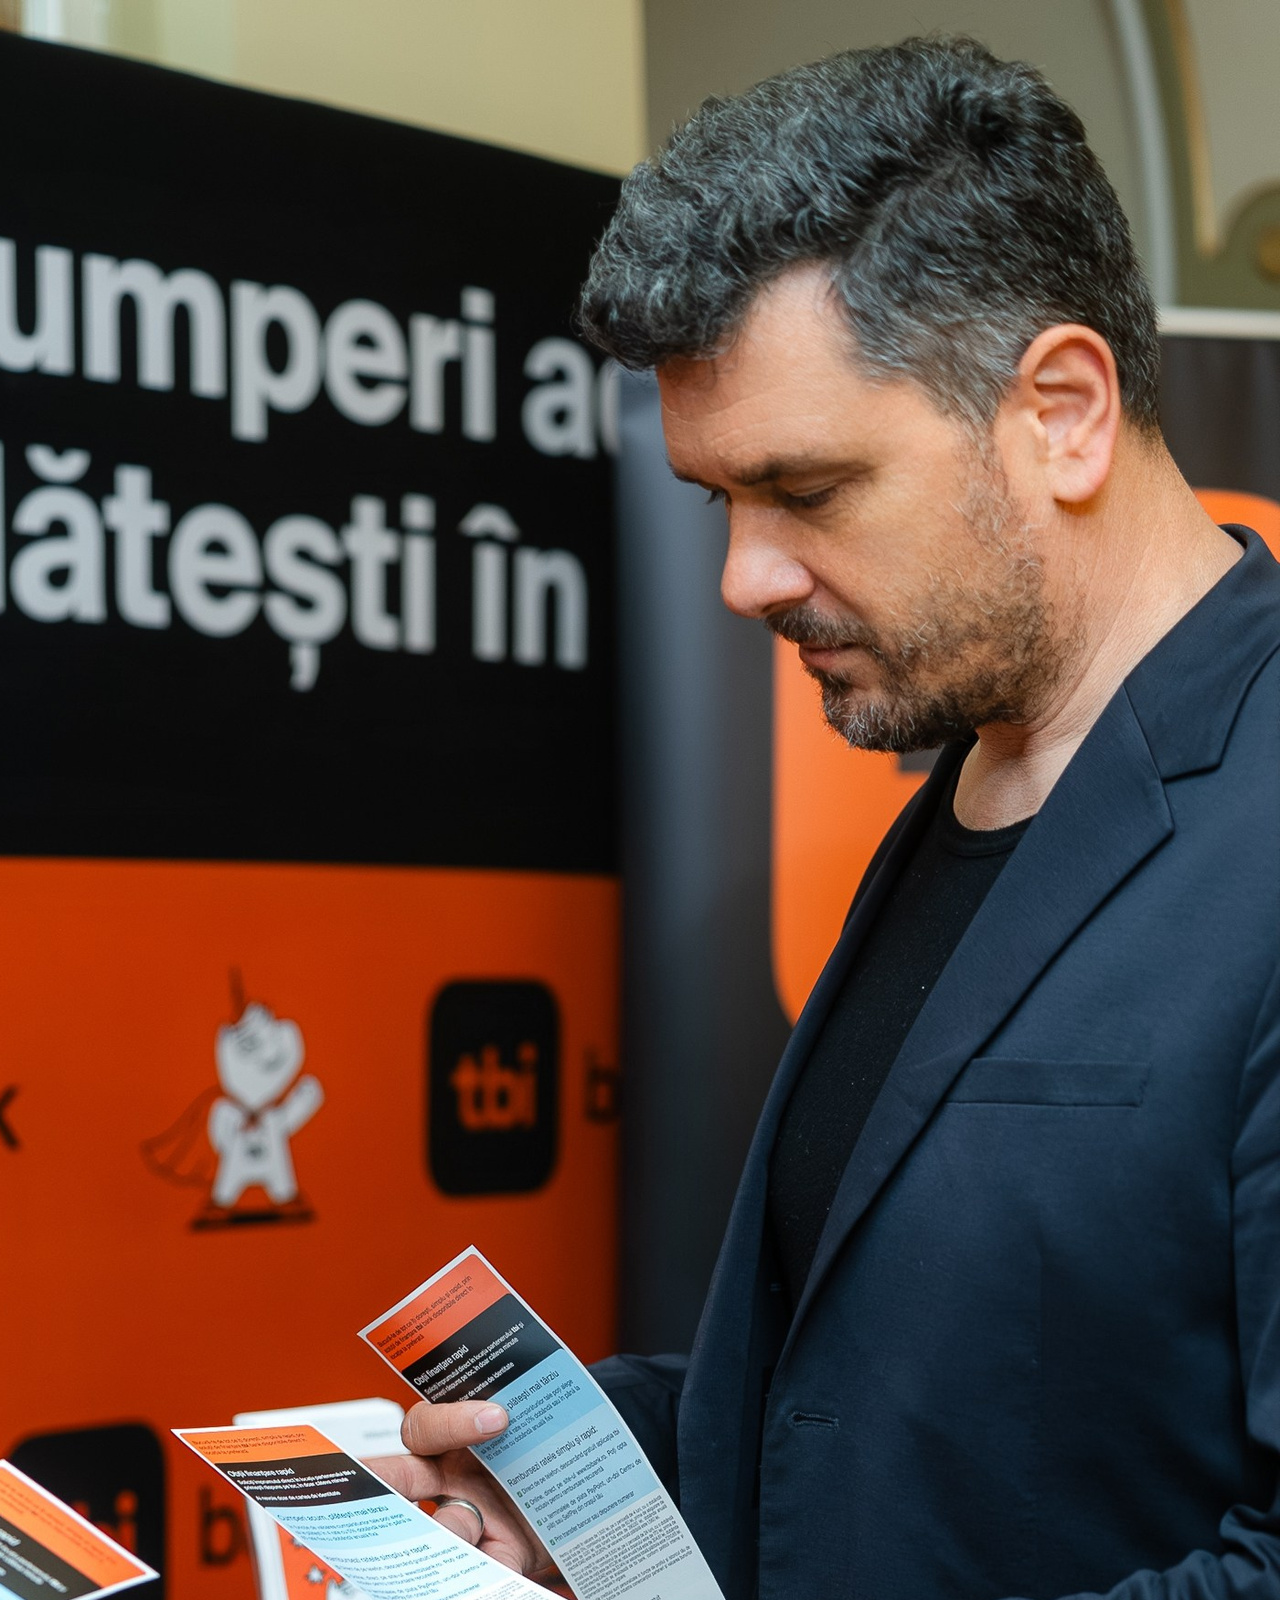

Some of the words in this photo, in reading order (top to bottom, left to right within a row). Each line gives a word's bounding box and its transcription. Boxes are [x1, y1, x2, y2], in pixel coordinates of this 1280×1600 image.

[460, 504, 589, 672] în
[451, 1042, 537, 1131] tbi
[511, 1324, 519, 1333] tbi
[450, 1344, 470, 1362] rapid
[528, 1381, 542, 1393] mai
[540, 1369, 559, 1385] târziu
[507, 1462, 540, 1487] Rambursezi
[539, 1451, 556, 1466] ratele
[555, 1439, 576, 1457] simplu
